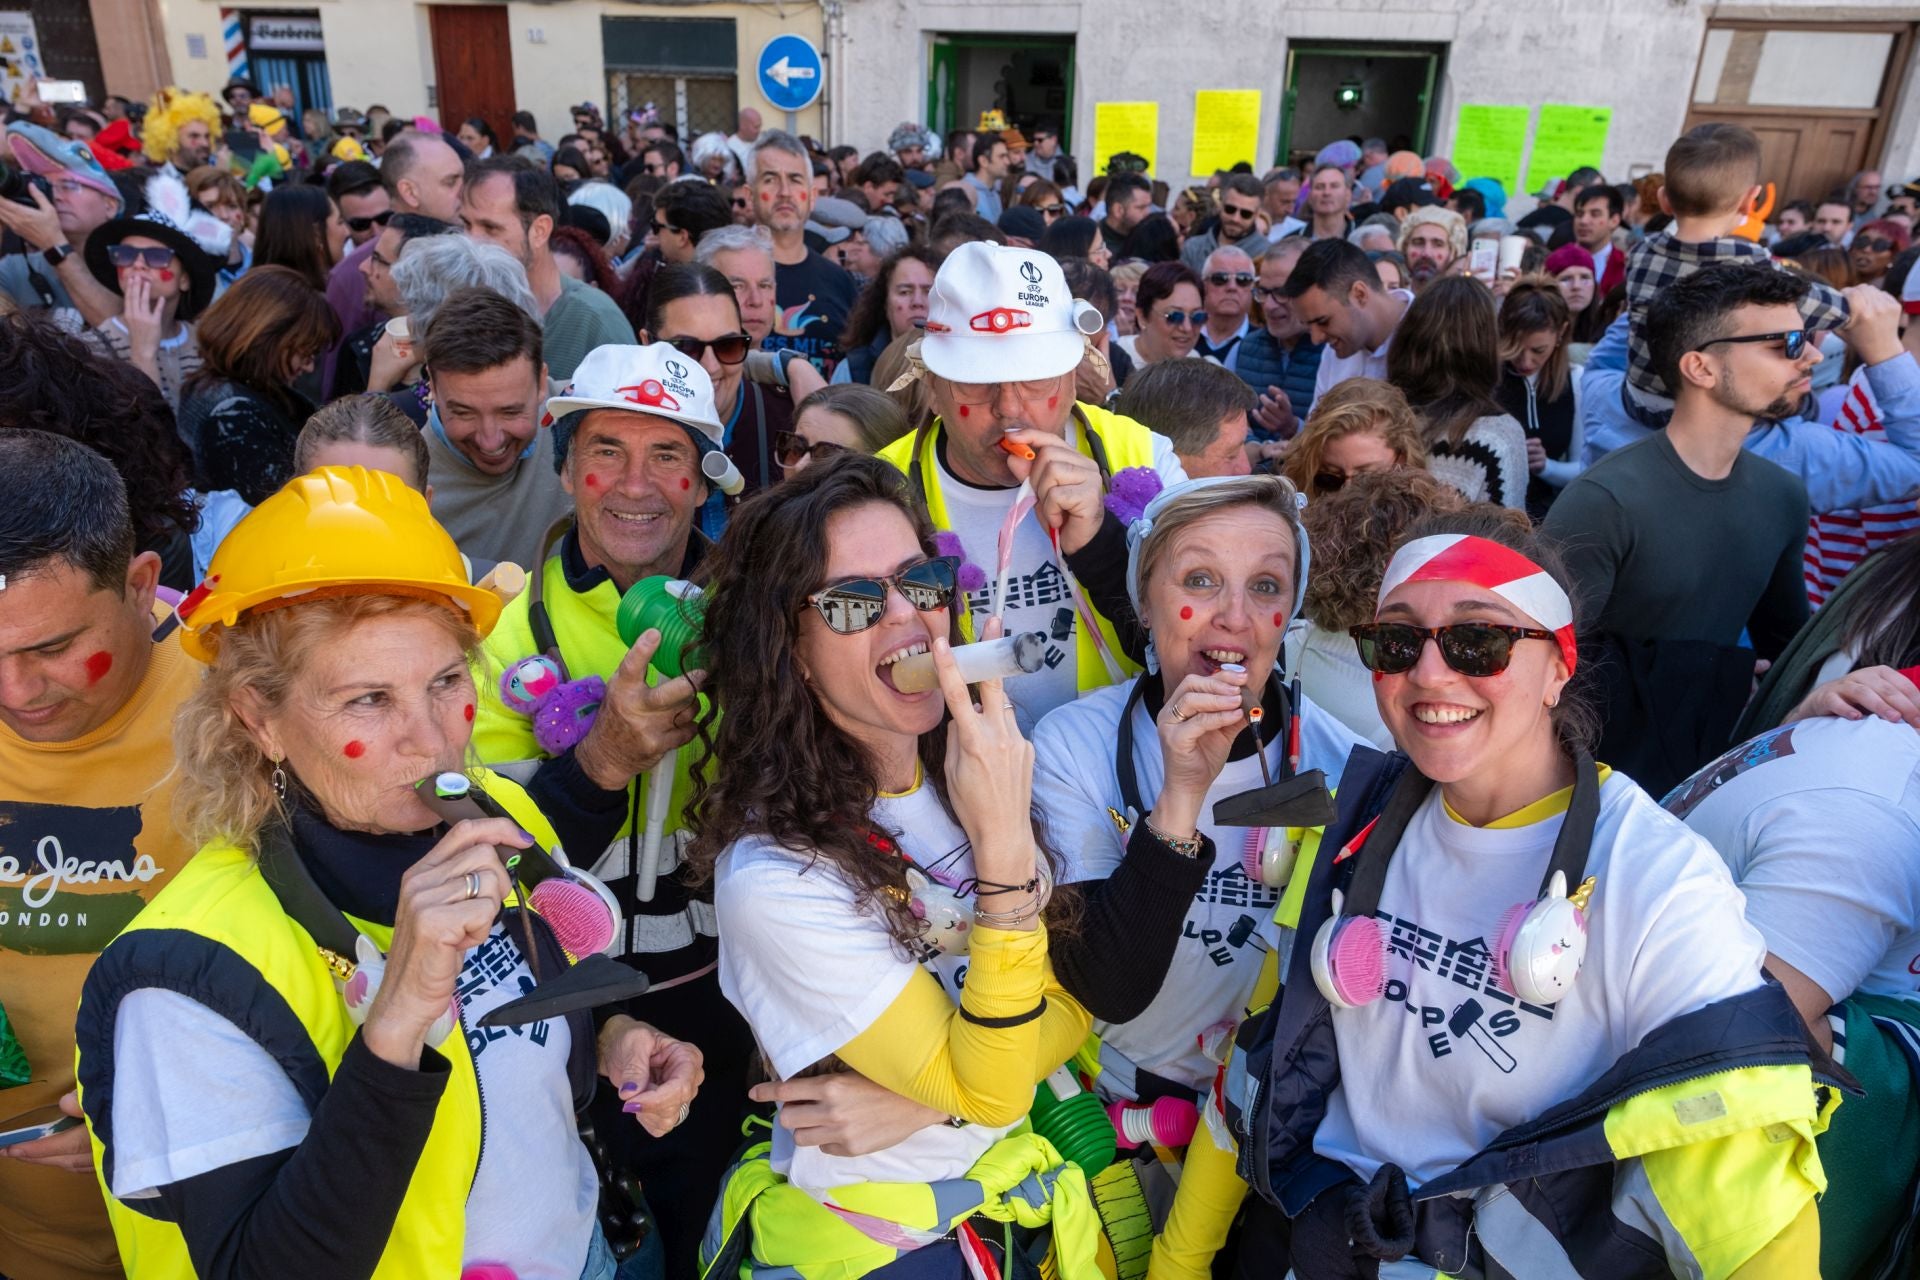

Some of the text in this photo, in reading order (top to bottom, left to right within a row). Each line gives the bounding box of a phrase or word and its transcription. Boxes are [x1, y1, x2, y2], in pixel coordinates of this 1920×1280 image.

[1018, 292, 1050, 304] EUROPA
[1025, 300, 1044, 308] LEAGUE
[662, 379, 695, 398] EUROPA
[22, 835, 165, 909] Jeans
[0, 911, 87, 927] ONDON
